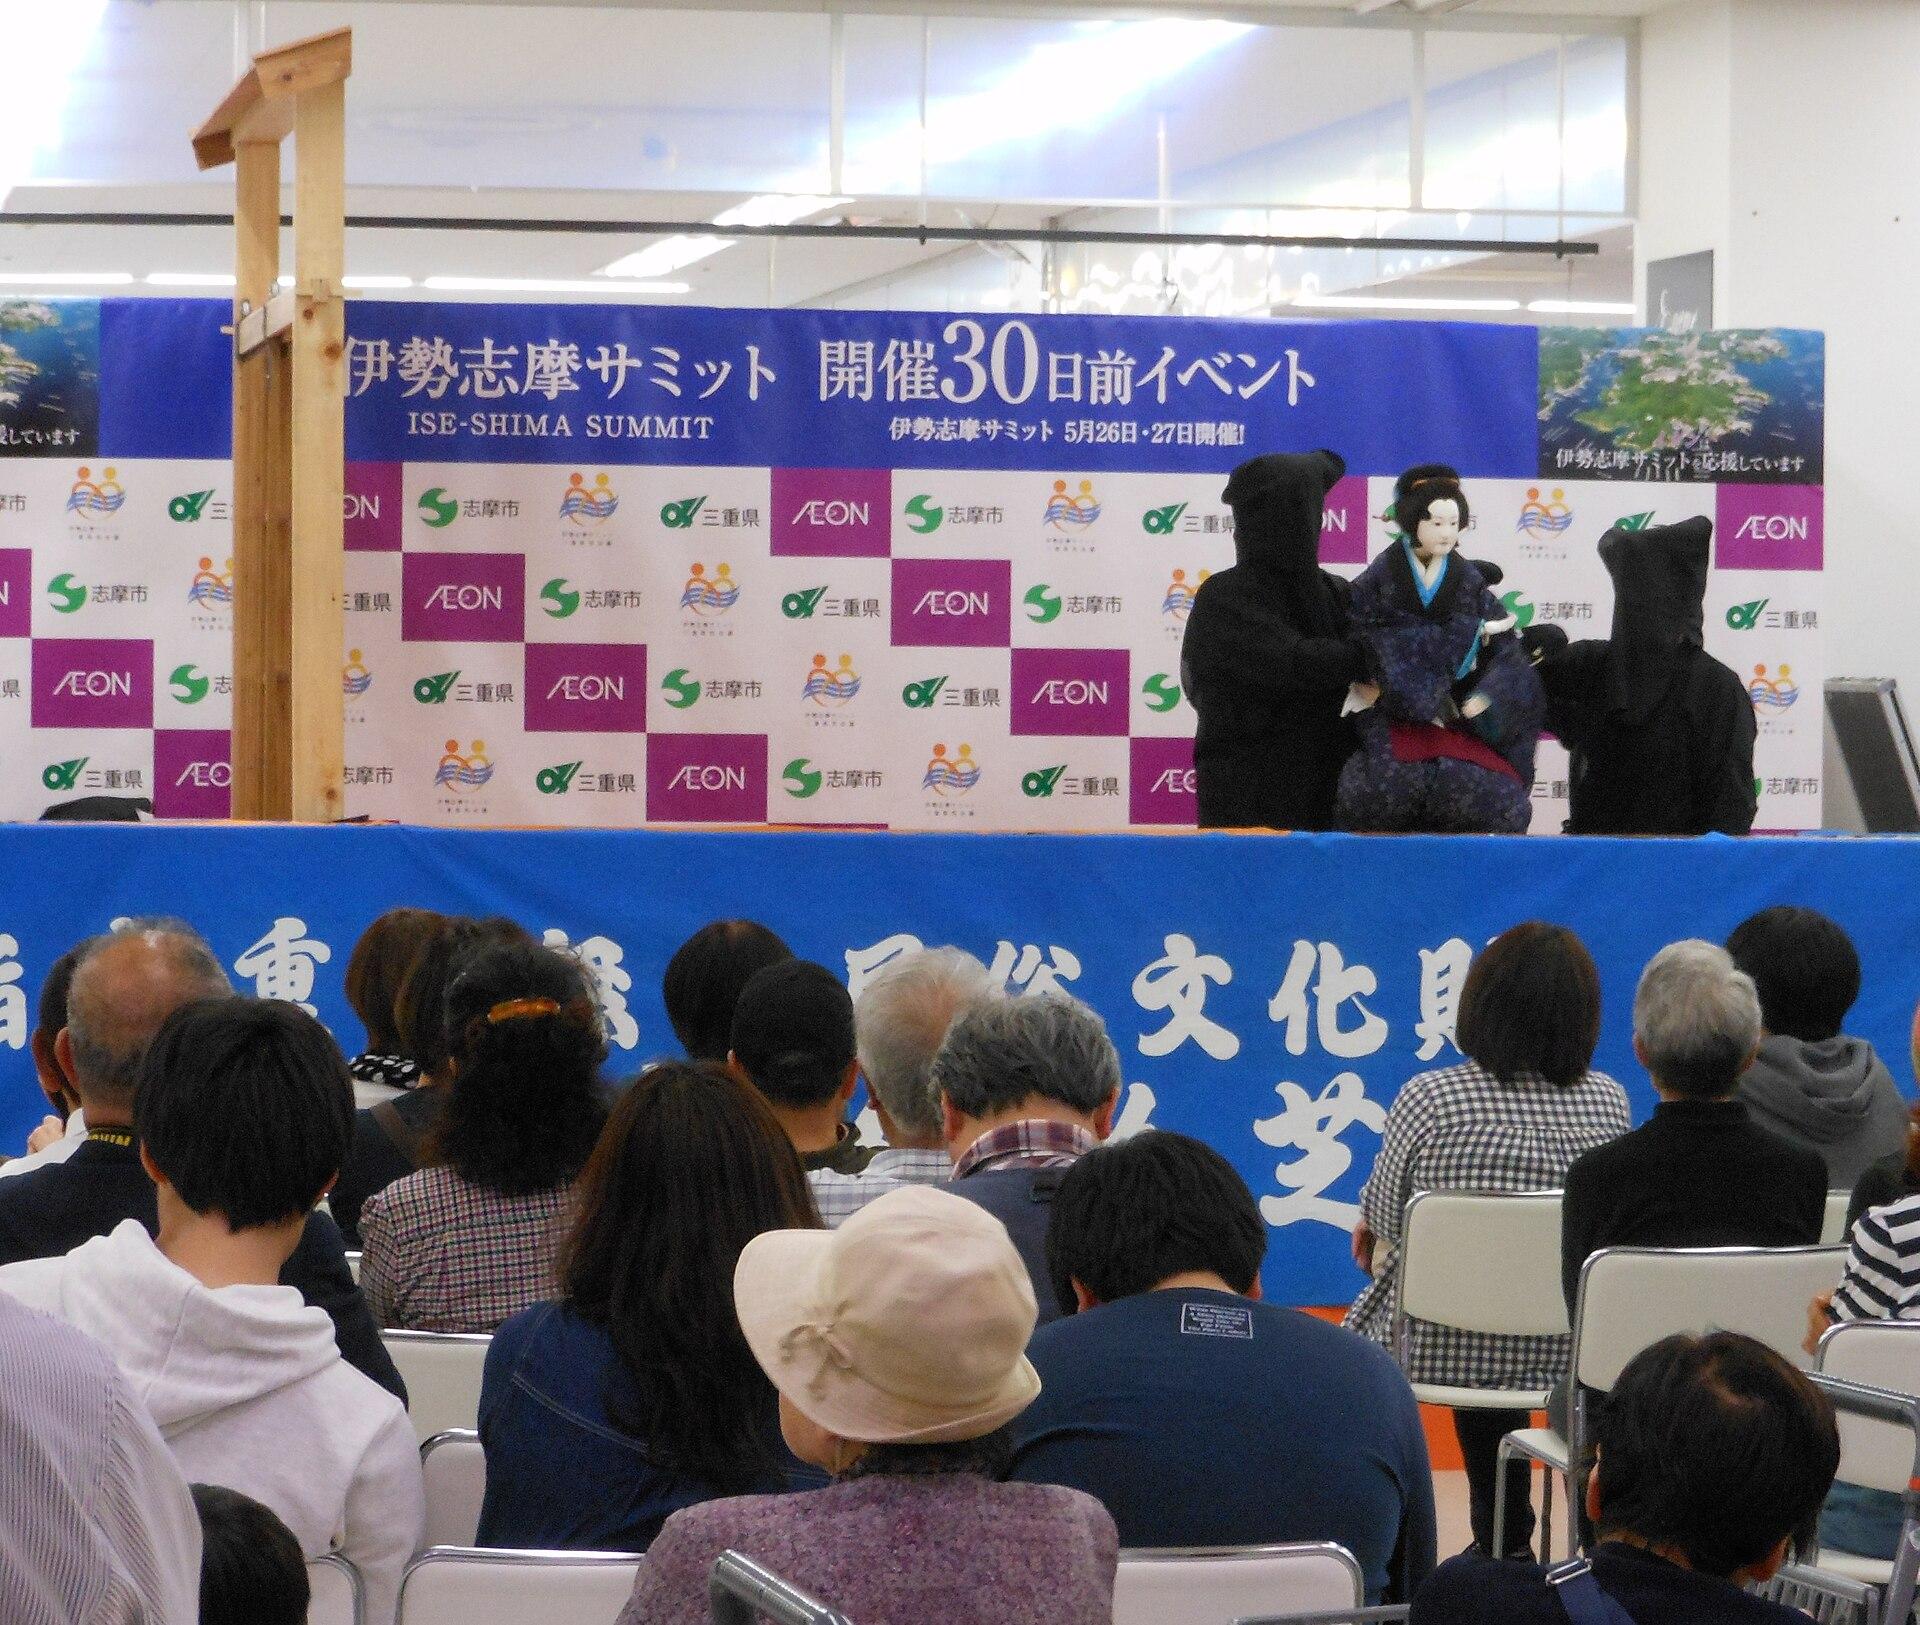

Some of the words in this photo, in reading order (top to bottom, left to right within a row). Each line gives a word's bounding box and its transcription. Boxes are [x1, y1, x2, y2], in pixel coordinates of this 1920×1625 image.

[343, 336, 777, 401] 伊勢志摩サミット
[819, 319, 1316, 406] 開催30日前イベント
[408, 411, 574, 438] ISE-SHIMA
[586, 414, 715, 440] SUMMIT
[702, 508, 760, 527] 三重県
[823, 598, 881, 617] 三重県
[456, 683, 514, 702] 三重県
[943, 688, 1001, 707] 三重県
[85, 770, 143, 788] 三重県
[579, 774, 636, 793] 三重県
[1063, 777, 1120, 796] 三重県
